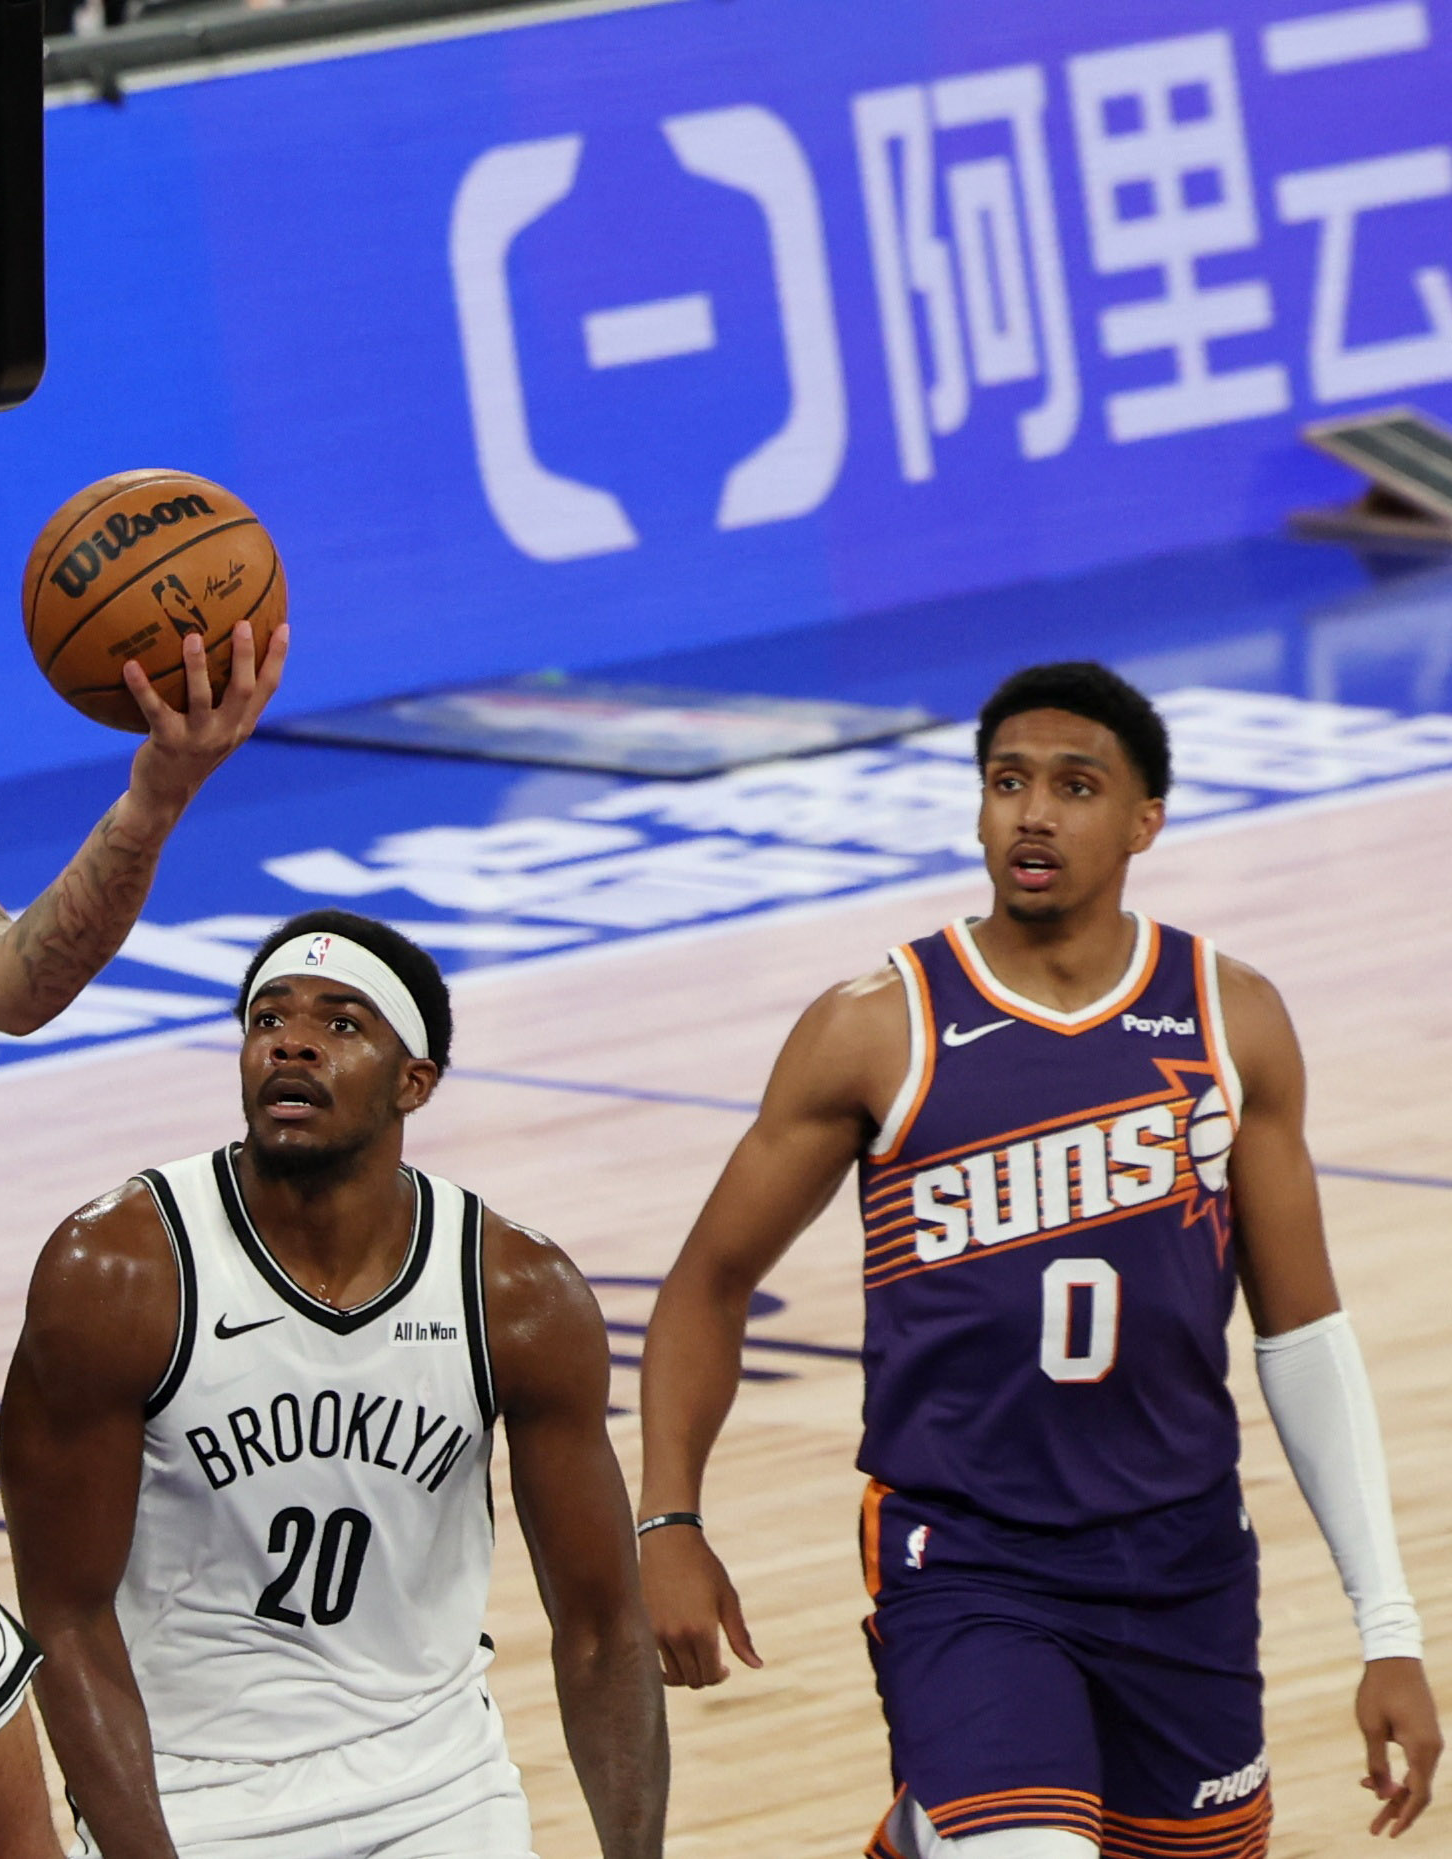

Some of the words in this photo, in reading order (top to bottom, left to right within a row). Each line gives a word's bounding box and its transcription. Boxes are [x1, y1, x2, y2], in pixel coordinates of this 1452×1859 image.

[850, 0, 1452, 484] 阿里云
[50, 493, 216, 600] Wilson
[1121, 1013, 1196, 1038] PayPal
[394, 1321, 413, 1341] All
[416, 1321, 428, 1341] In
[429, 1321, 458, 1341] Won
[1039, 1257, 1123, 1384] 0
[185, 1389, 473, 1494] BROOKLYN
[254, 1505, 372, 1628] 20
